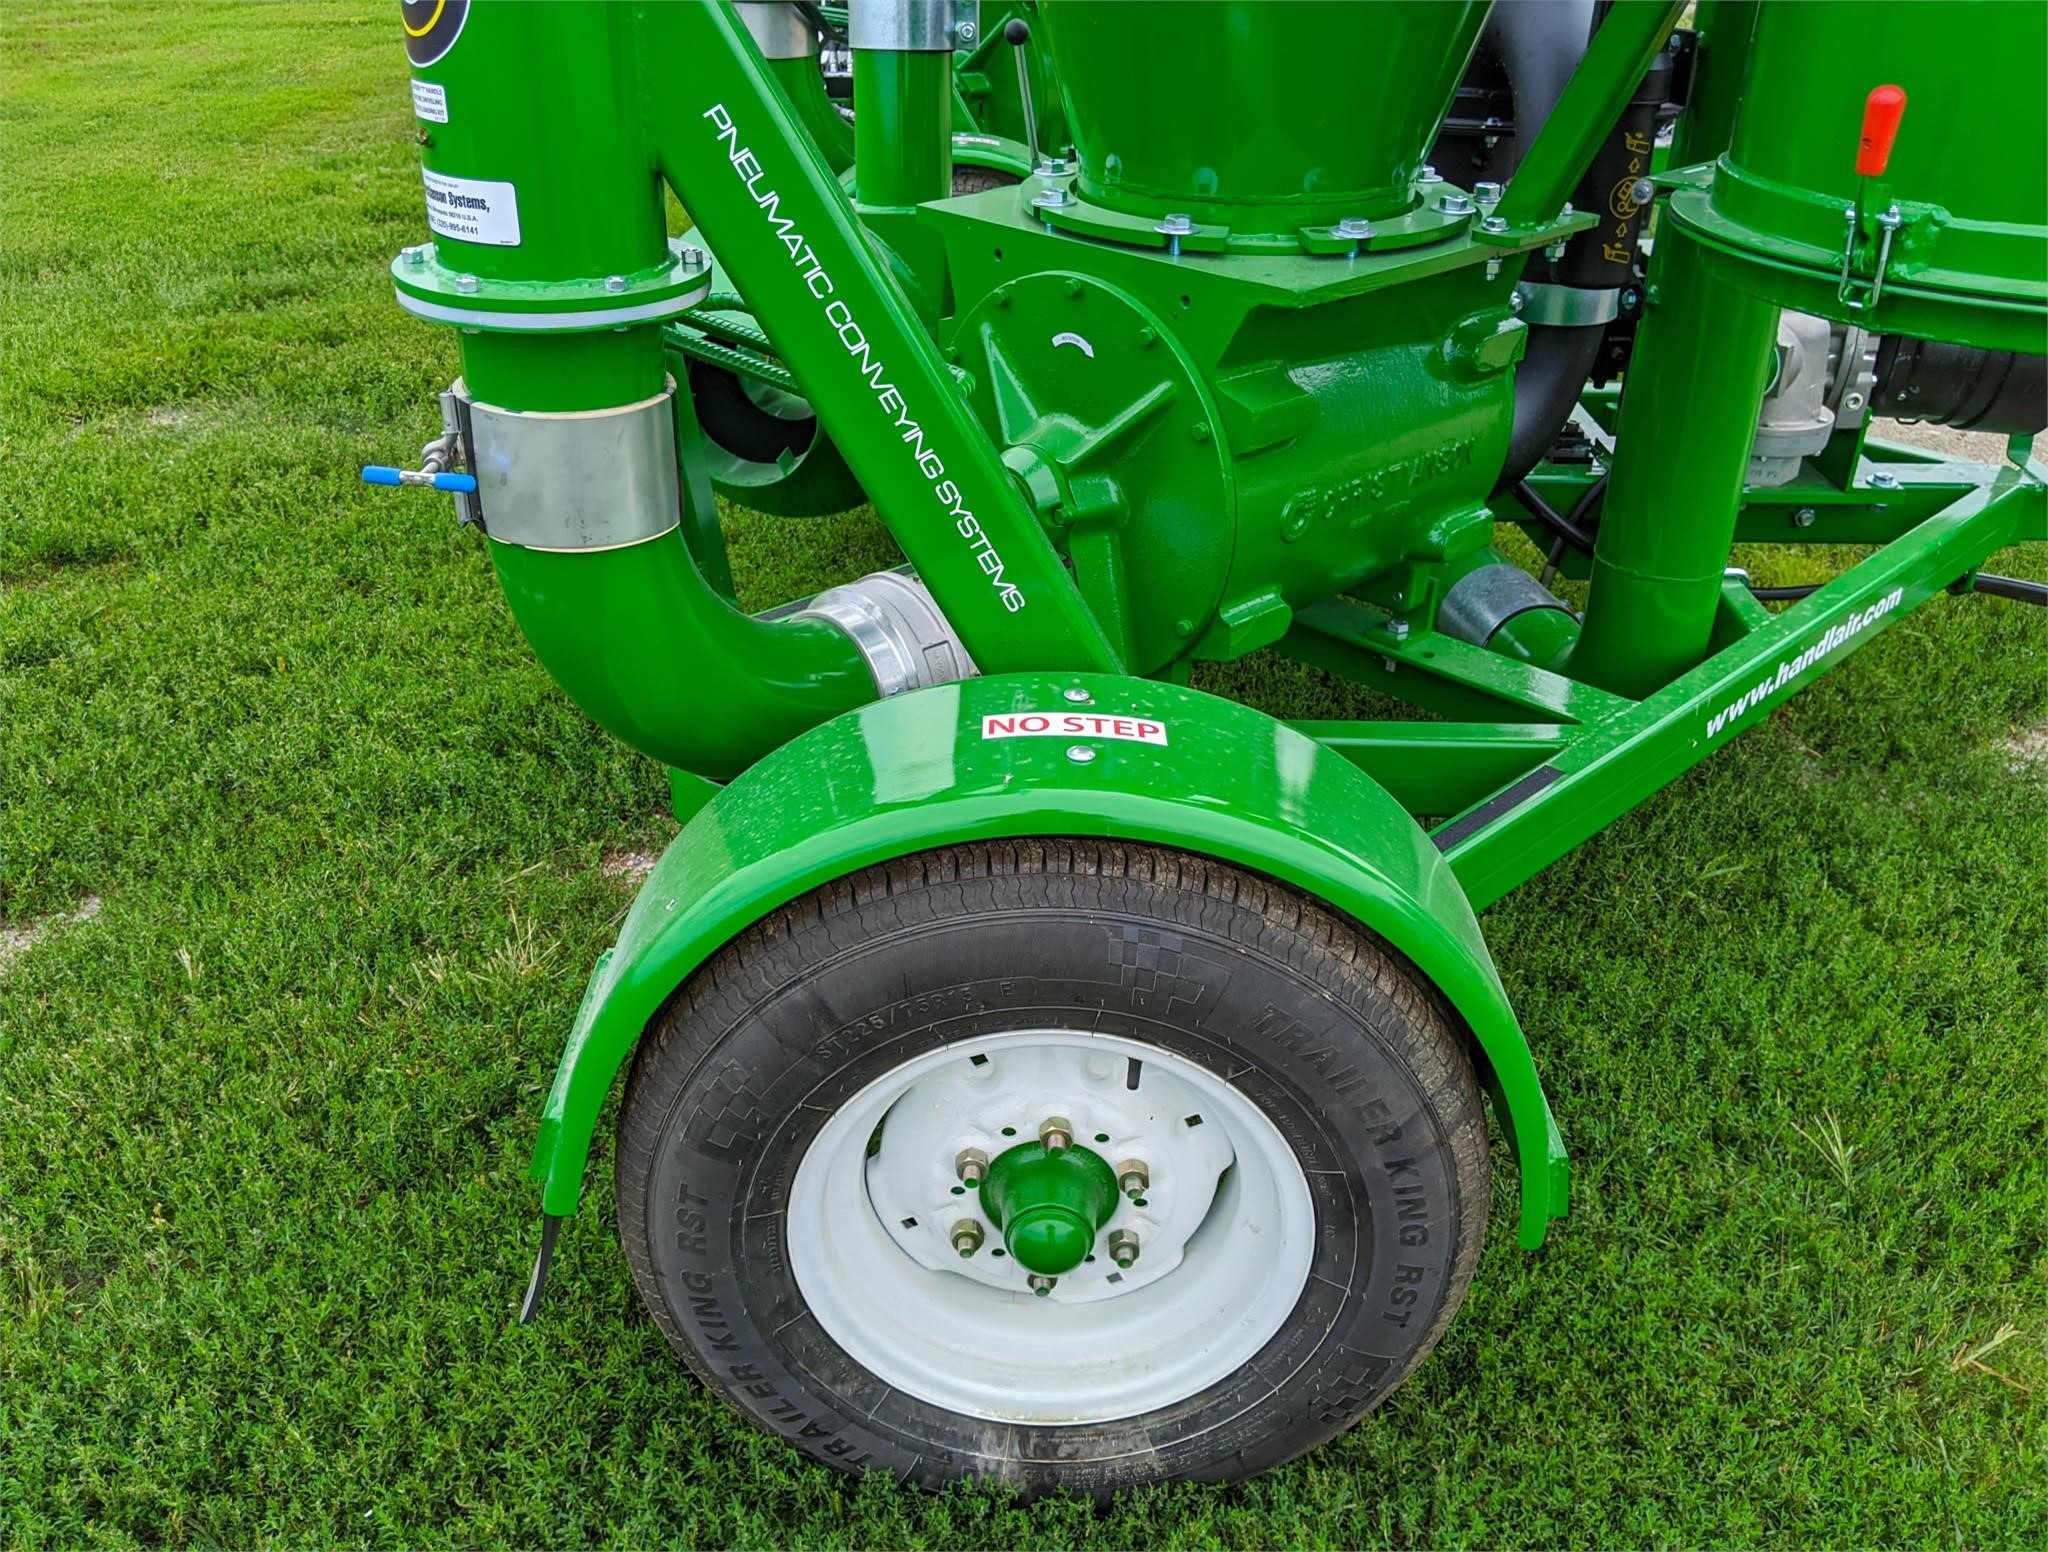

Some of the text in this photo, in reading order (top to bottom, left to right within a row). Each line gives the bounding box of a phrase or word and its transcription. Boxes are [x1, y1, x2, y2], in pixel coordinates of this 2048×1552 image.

[448, 191, 490, 213] Systems,
[703, 103, 1026, 612] PNEUMATIC CONVEYING SYSTEMS
[1706, 587, 1904, 739] www.handlair.com
[988, 716, 1160, 739] NO STEP
[1252, 1001, 1403, 1147] TRAILER
[675, 1182, 710, 1256] RST
[1383, 1156, 1431, 1247] KING
[680, 1268, 743, 1352] KING
[1381, 1263, 1426, 1329] RST
[728, 1362, 874, 1466] TRAILER
